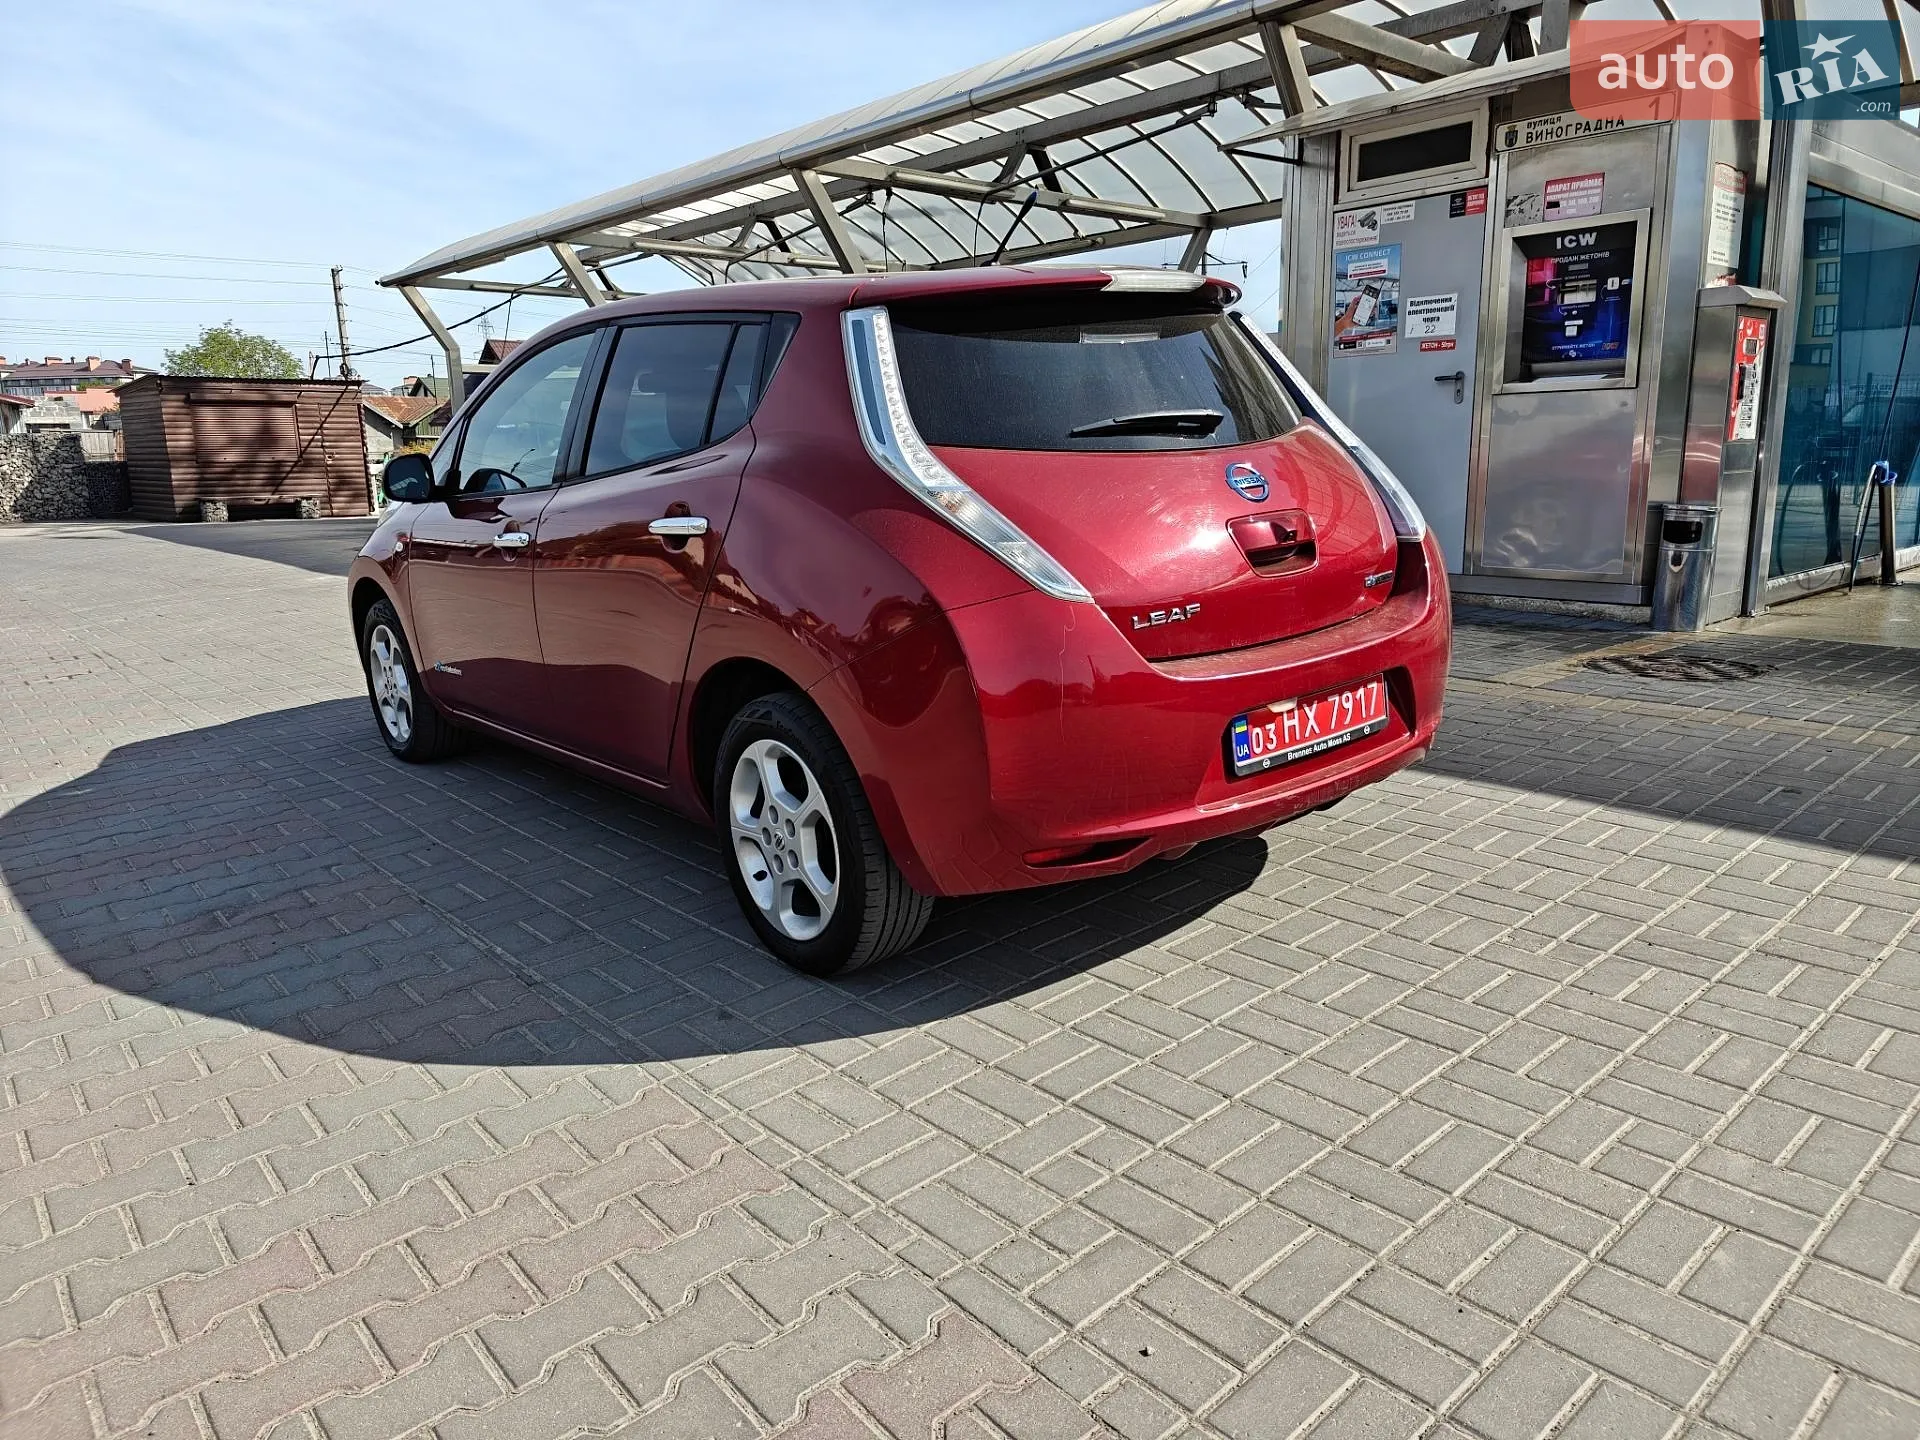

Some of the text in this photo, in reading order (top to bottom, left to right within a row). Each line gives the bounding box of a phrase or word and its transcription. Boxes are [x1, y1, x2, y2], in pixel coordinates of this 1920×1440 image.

[1525, 96, 1661, 144] ВИНОГРАДНА 1
[1526, 115, 1562, 130] вулиця
[1546, 182, 1571, 194] АПАРАТ
[1556, 232, 1597, 249] ICW
[1360, 248, 1391, 259] CONNECT
[1550, 251, 1610, 264] ПРОДАЖ ЖЕТОНІВ
[1132, 603, 1201, 630] LEAF
[1237, 681, 1378, 757] UA 03 HX 7917
[1313, 743, 1328, 752] Auto
[1327, 738, 1343, 748] Moss
[1343, 733, 1351, 743] AS
